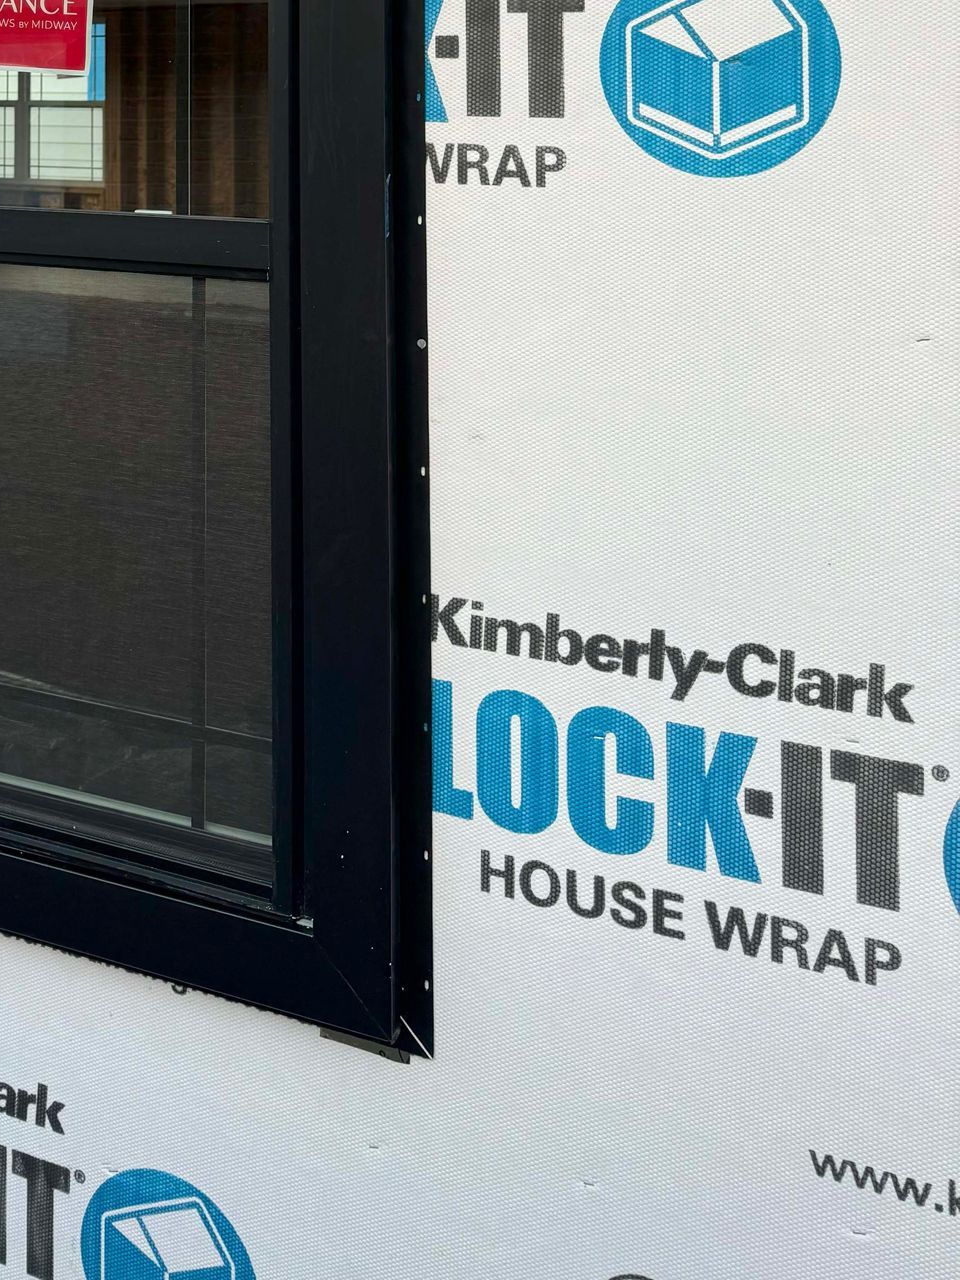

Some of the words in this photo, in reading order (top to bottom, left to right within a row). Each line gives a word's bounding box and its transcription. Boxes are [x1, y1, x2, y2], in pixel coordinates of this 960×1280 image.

[32, 19, 78, 31] MIDWAY
[431, 592, 915, 724] Kimberly-Clark
[479, 848, 686, 941] HOUSE
[704, 899, 903, 987] WRAP
